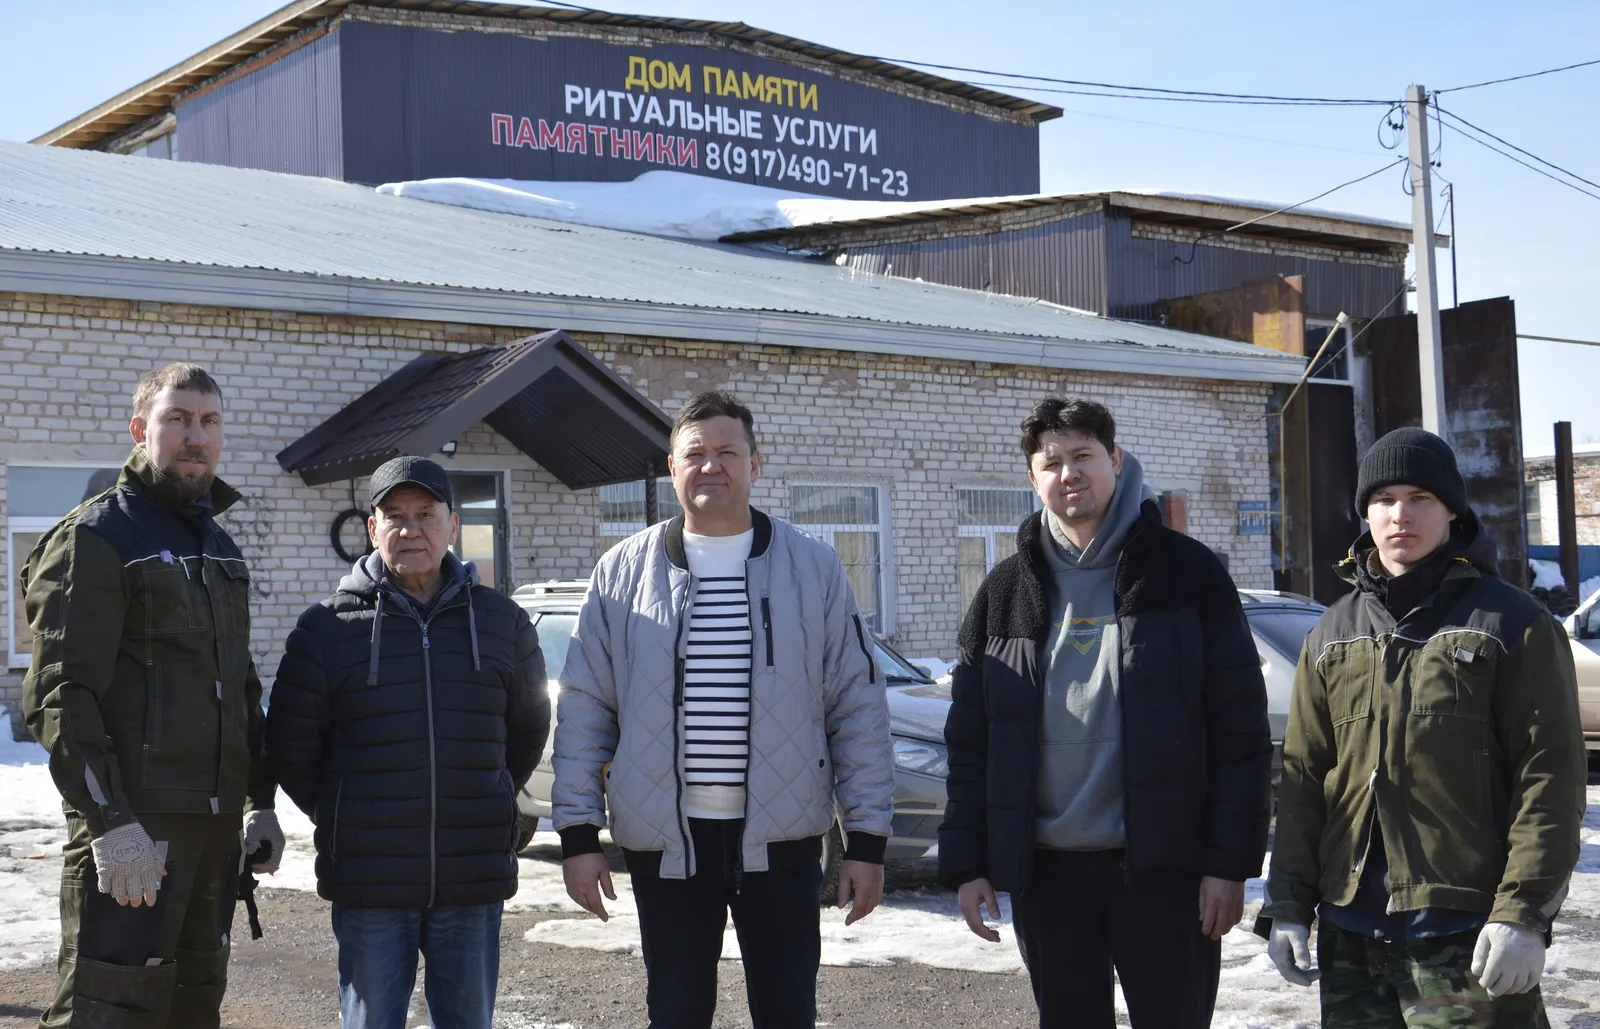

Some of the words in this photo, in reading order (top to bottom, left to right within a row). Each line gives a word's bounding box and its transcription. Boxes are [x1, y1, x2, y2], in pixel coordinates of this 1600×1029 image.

[625, 55, 691, 93] ДОМ
[703, 65, 819, 112] ПАМЯТИ
[491, 113, 698, 169] ПАМЯТНИКИ
[705, 141, 909, 197] 8(917)490-71-23
[564, 84, 763, 140] РИТУАЛЬНЫЕ
[772, 114, 877, 156] УСЛУГИ
